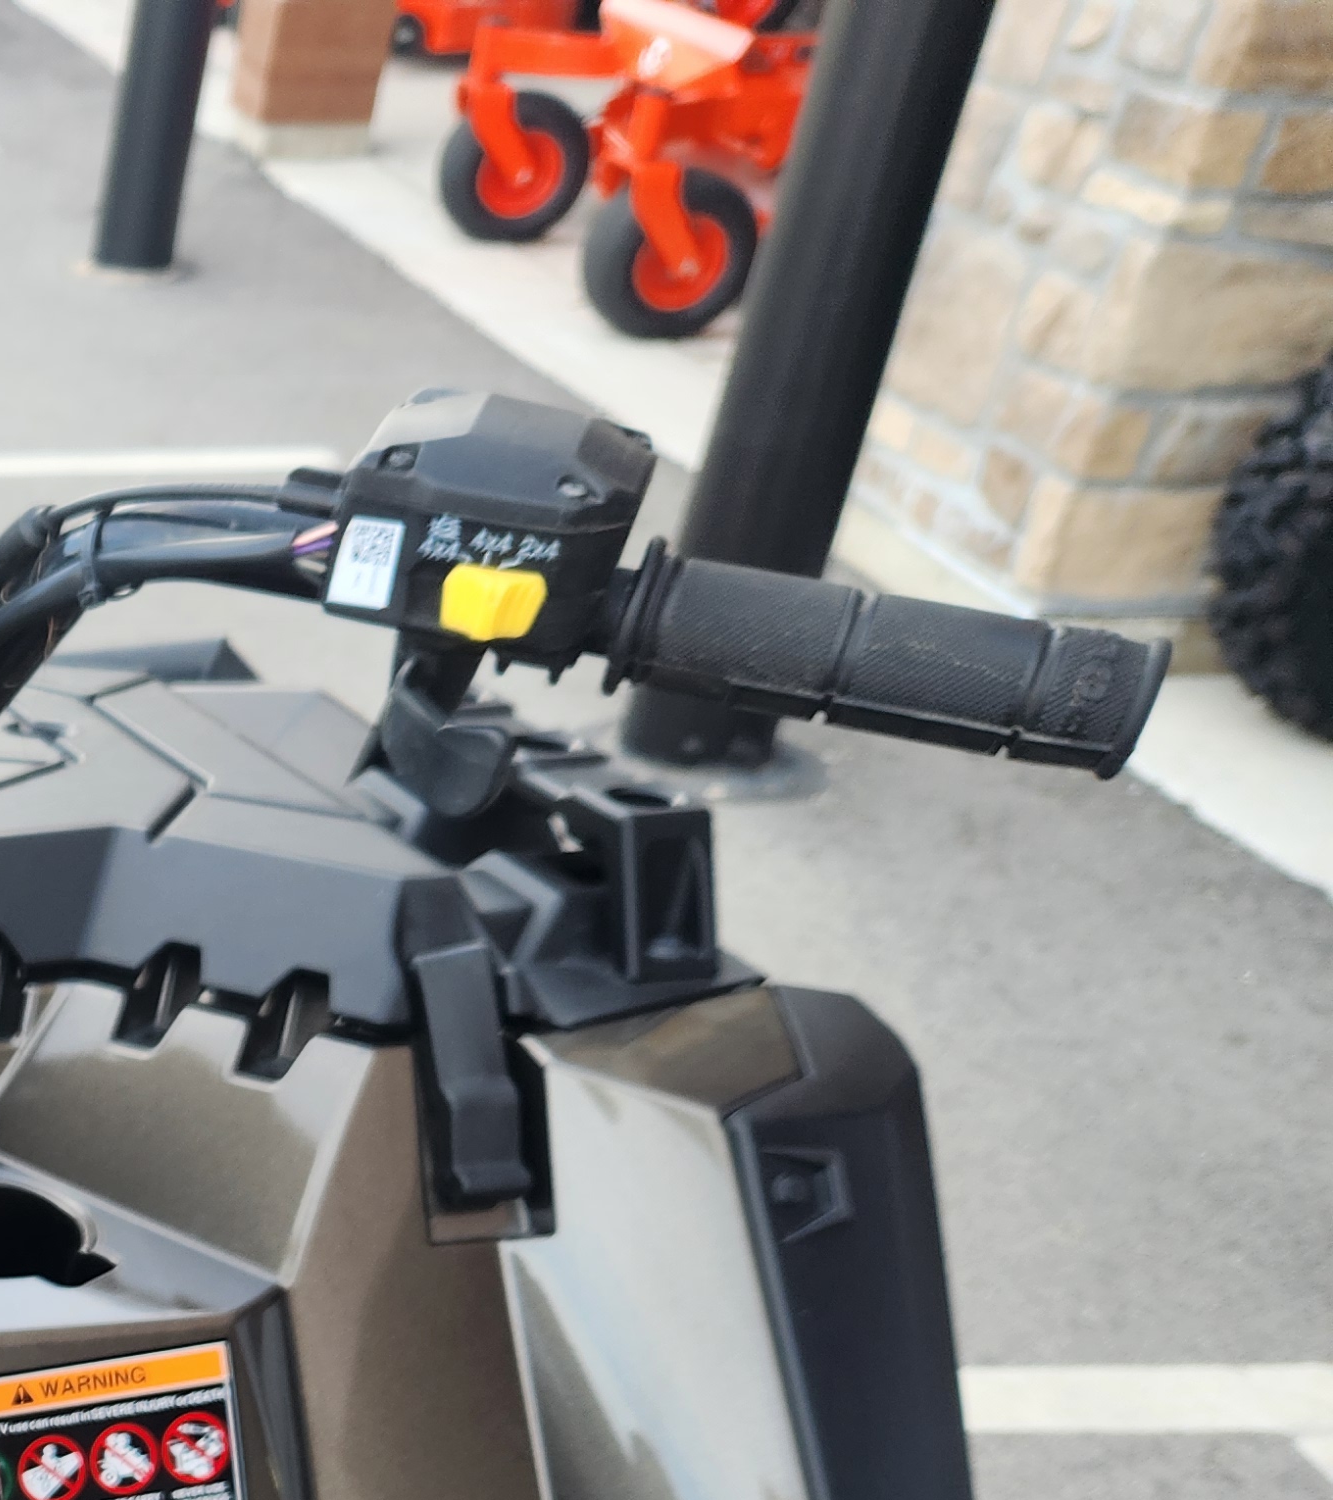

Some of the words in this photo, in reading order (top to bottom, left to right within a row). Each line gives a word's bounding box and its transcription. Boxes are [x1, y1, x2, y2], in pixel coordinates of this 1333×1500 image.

[39, 1366, 146, 1398] WARNING
[9, 1421, 28, 1432] use
[29, 1417, 48, 1430] can
[50, 1410, 79, 1427] result
[93, 1399, 135, 1418] SEVERE
[135, 1395, 175, 1413] INJURY
